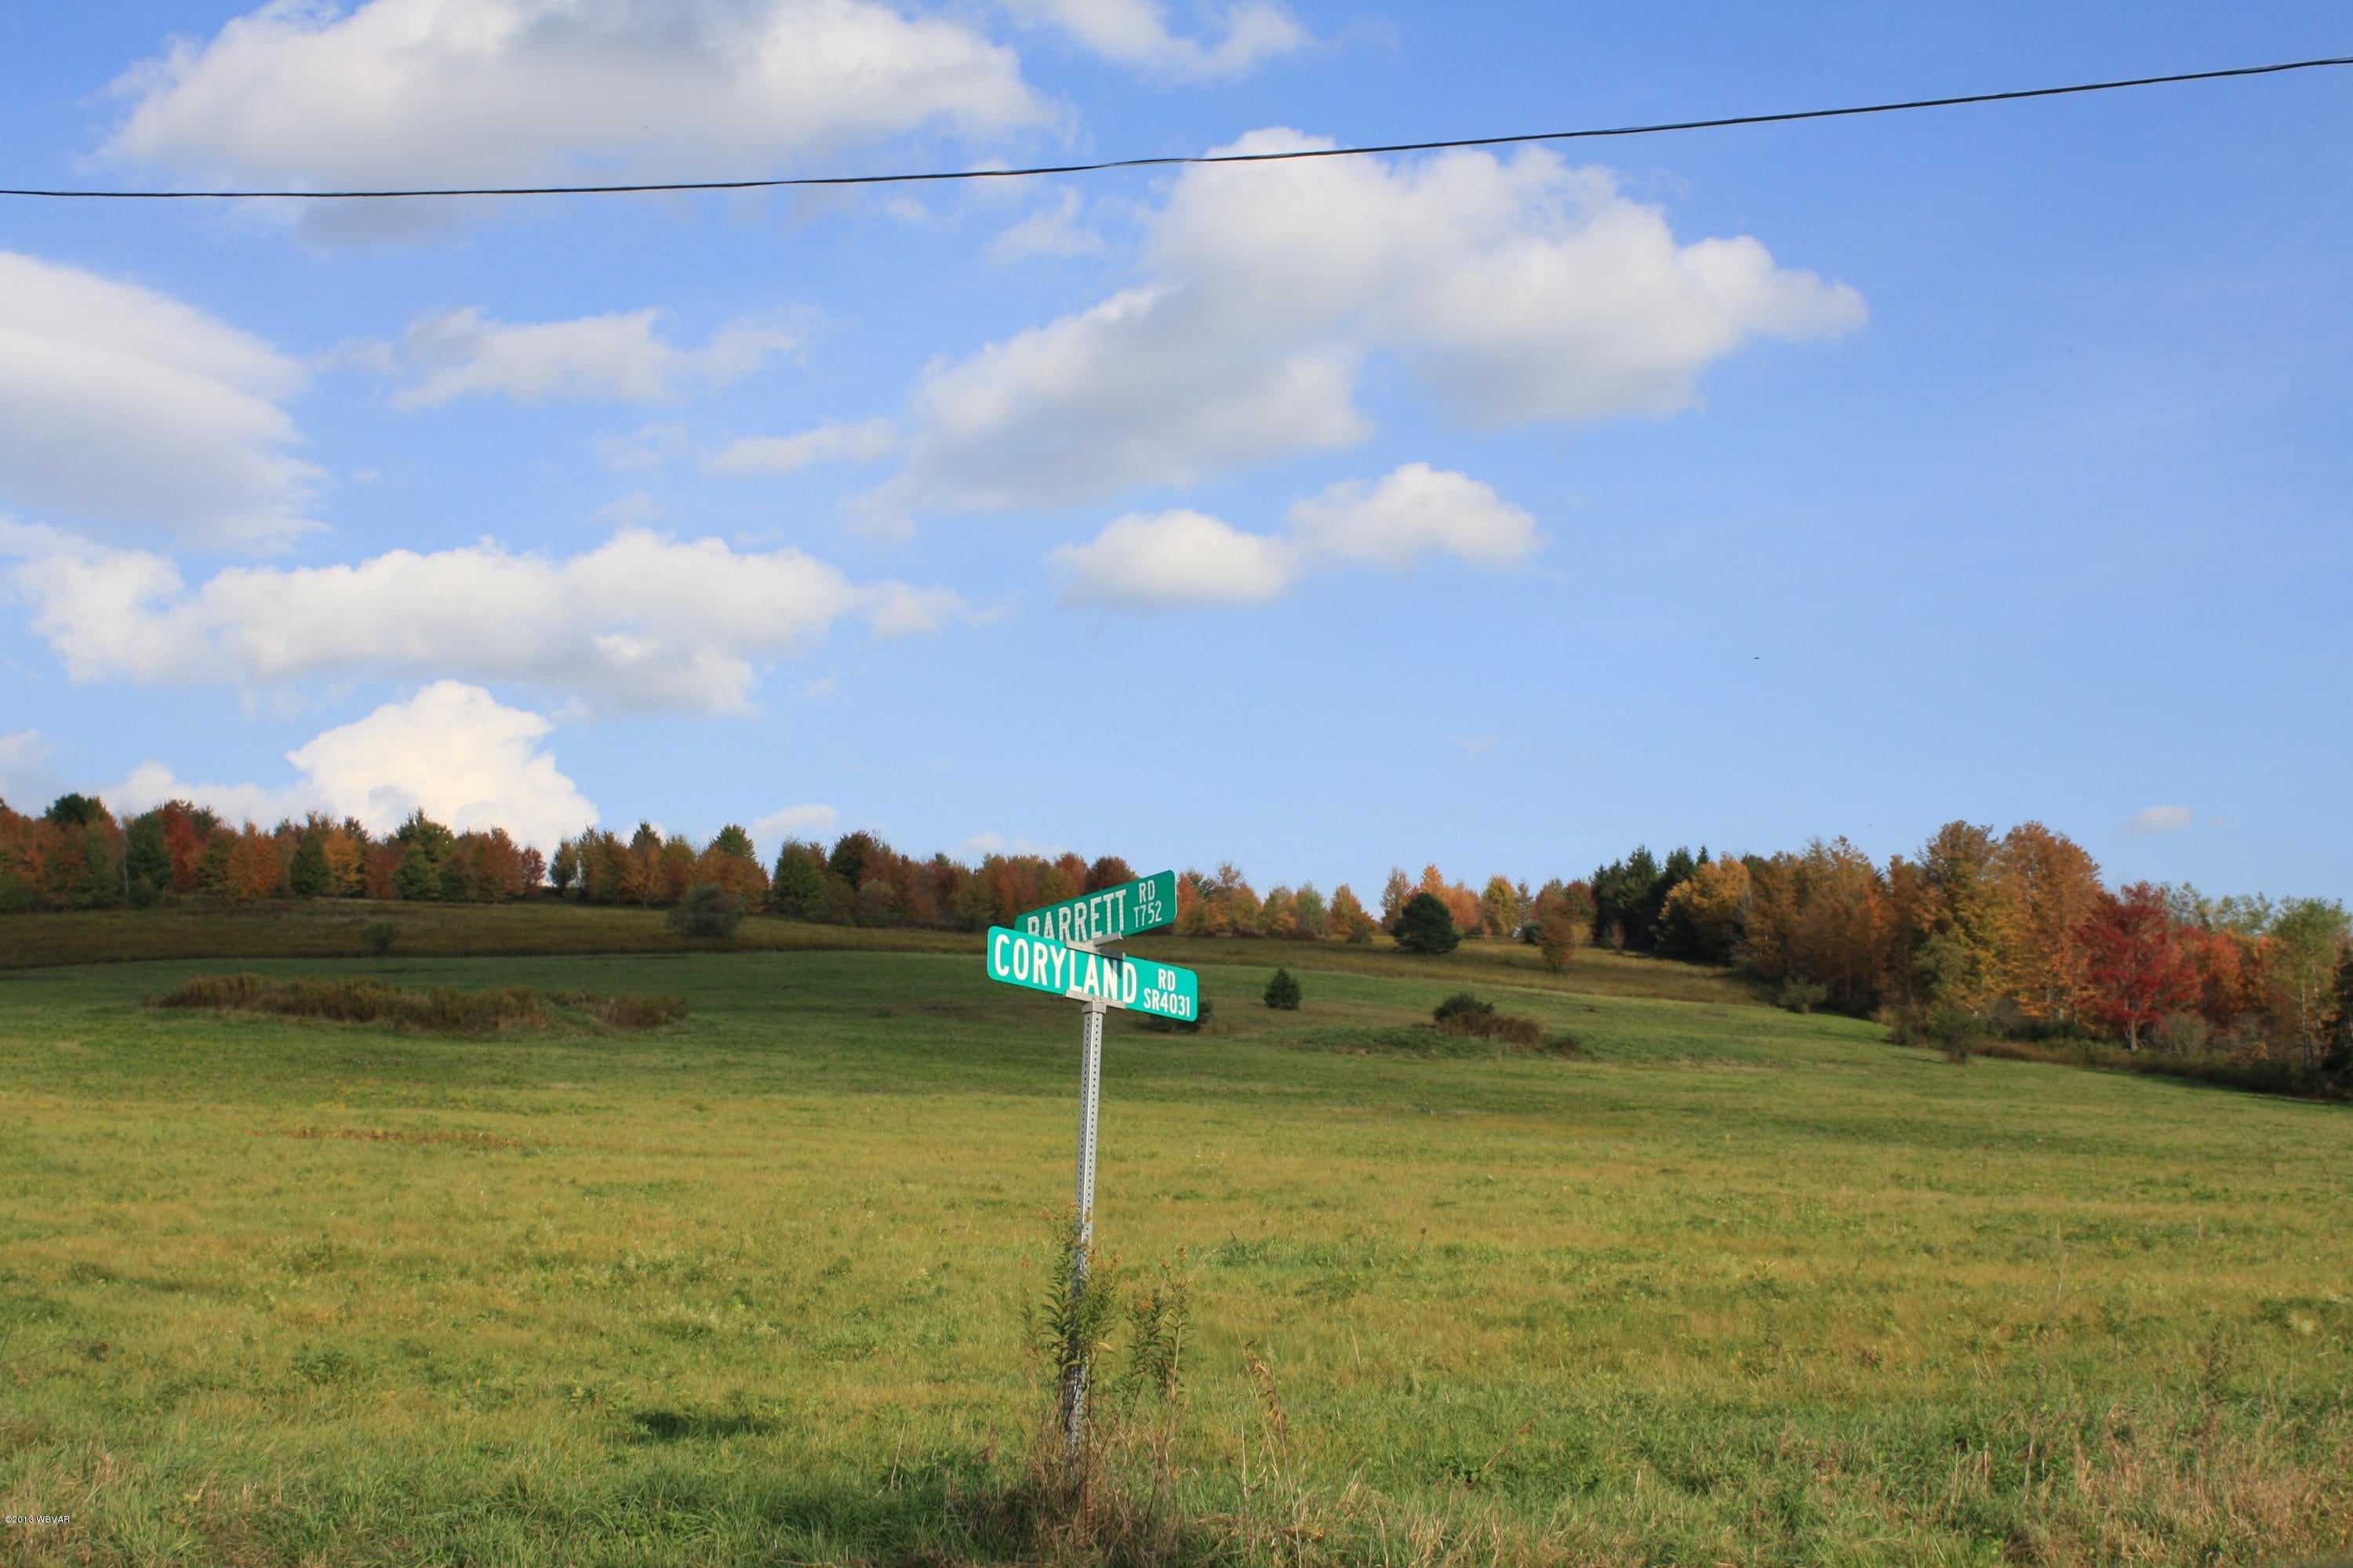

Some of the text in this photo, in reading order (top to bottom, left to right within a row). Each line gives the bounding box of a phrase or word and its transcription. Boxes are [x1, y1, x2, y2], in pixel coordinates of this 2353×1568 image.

[1139, 879, 1155, 904] RD
[1133, 900, 1162, 928] T752
[995, 934, 1176, 1004] CORYLAND RD
[1144, 988, 1191, 1017] SR4031
